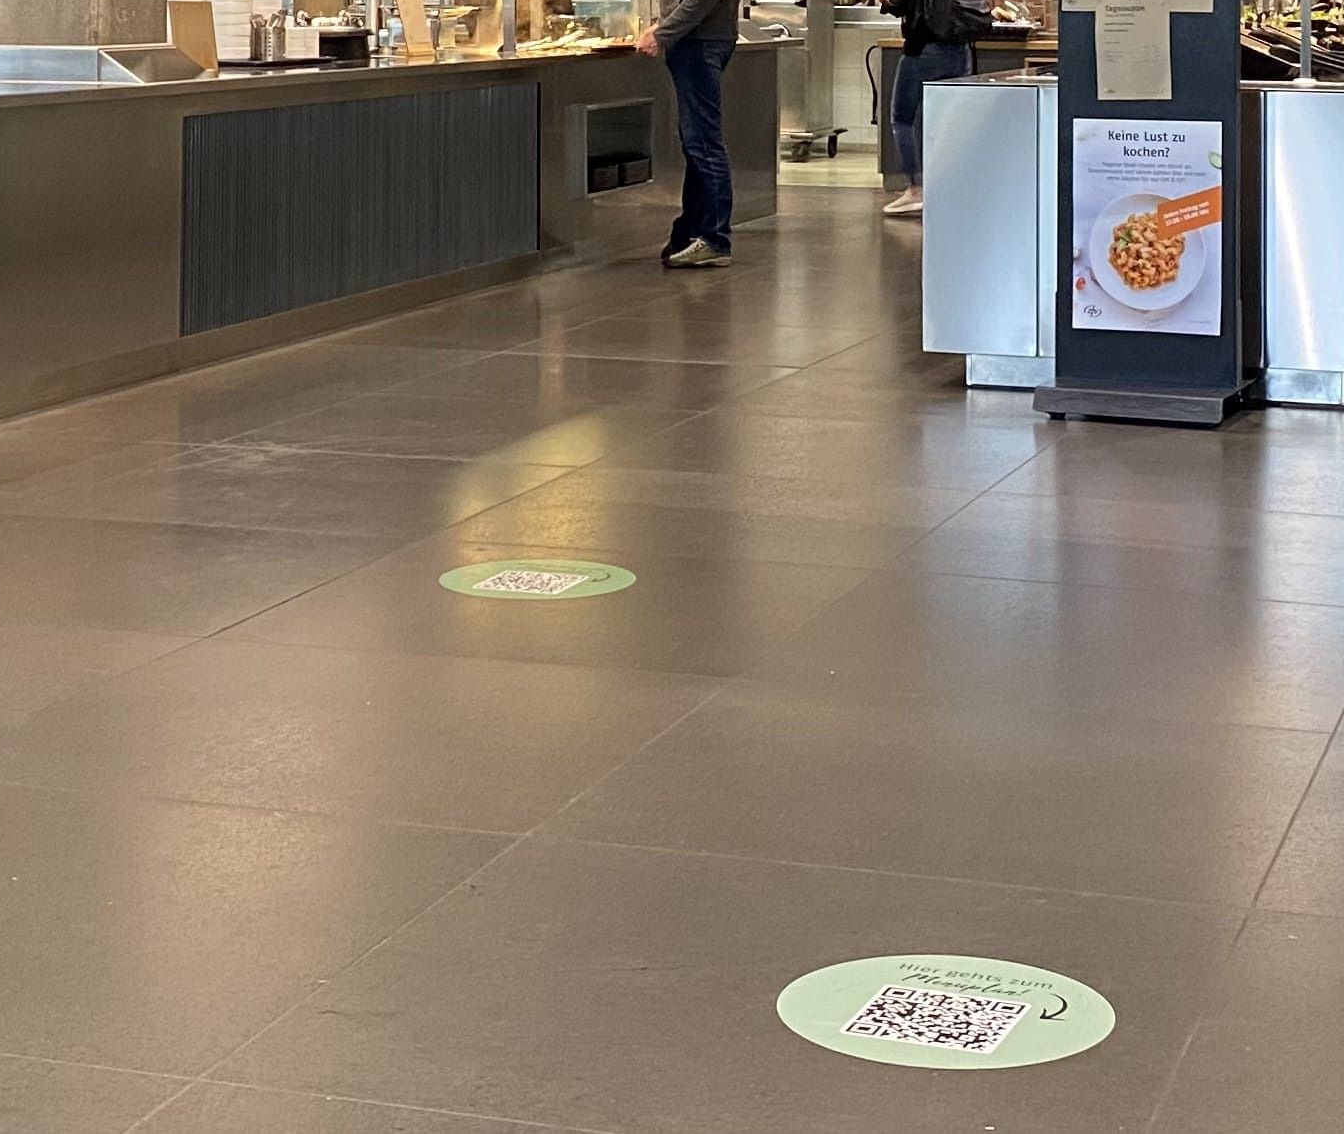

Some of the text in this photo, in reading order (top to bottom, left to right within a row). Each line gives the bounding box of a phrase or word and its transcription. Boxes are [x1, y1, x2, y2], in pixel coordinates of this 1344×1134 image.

[1108, 130, 1186, 143] Keine Lust zu
[1123, 145, 1171, 158] kochen?
[899, 962, 942, 974] Hier
[1009, 978, 1054, 990] zum
